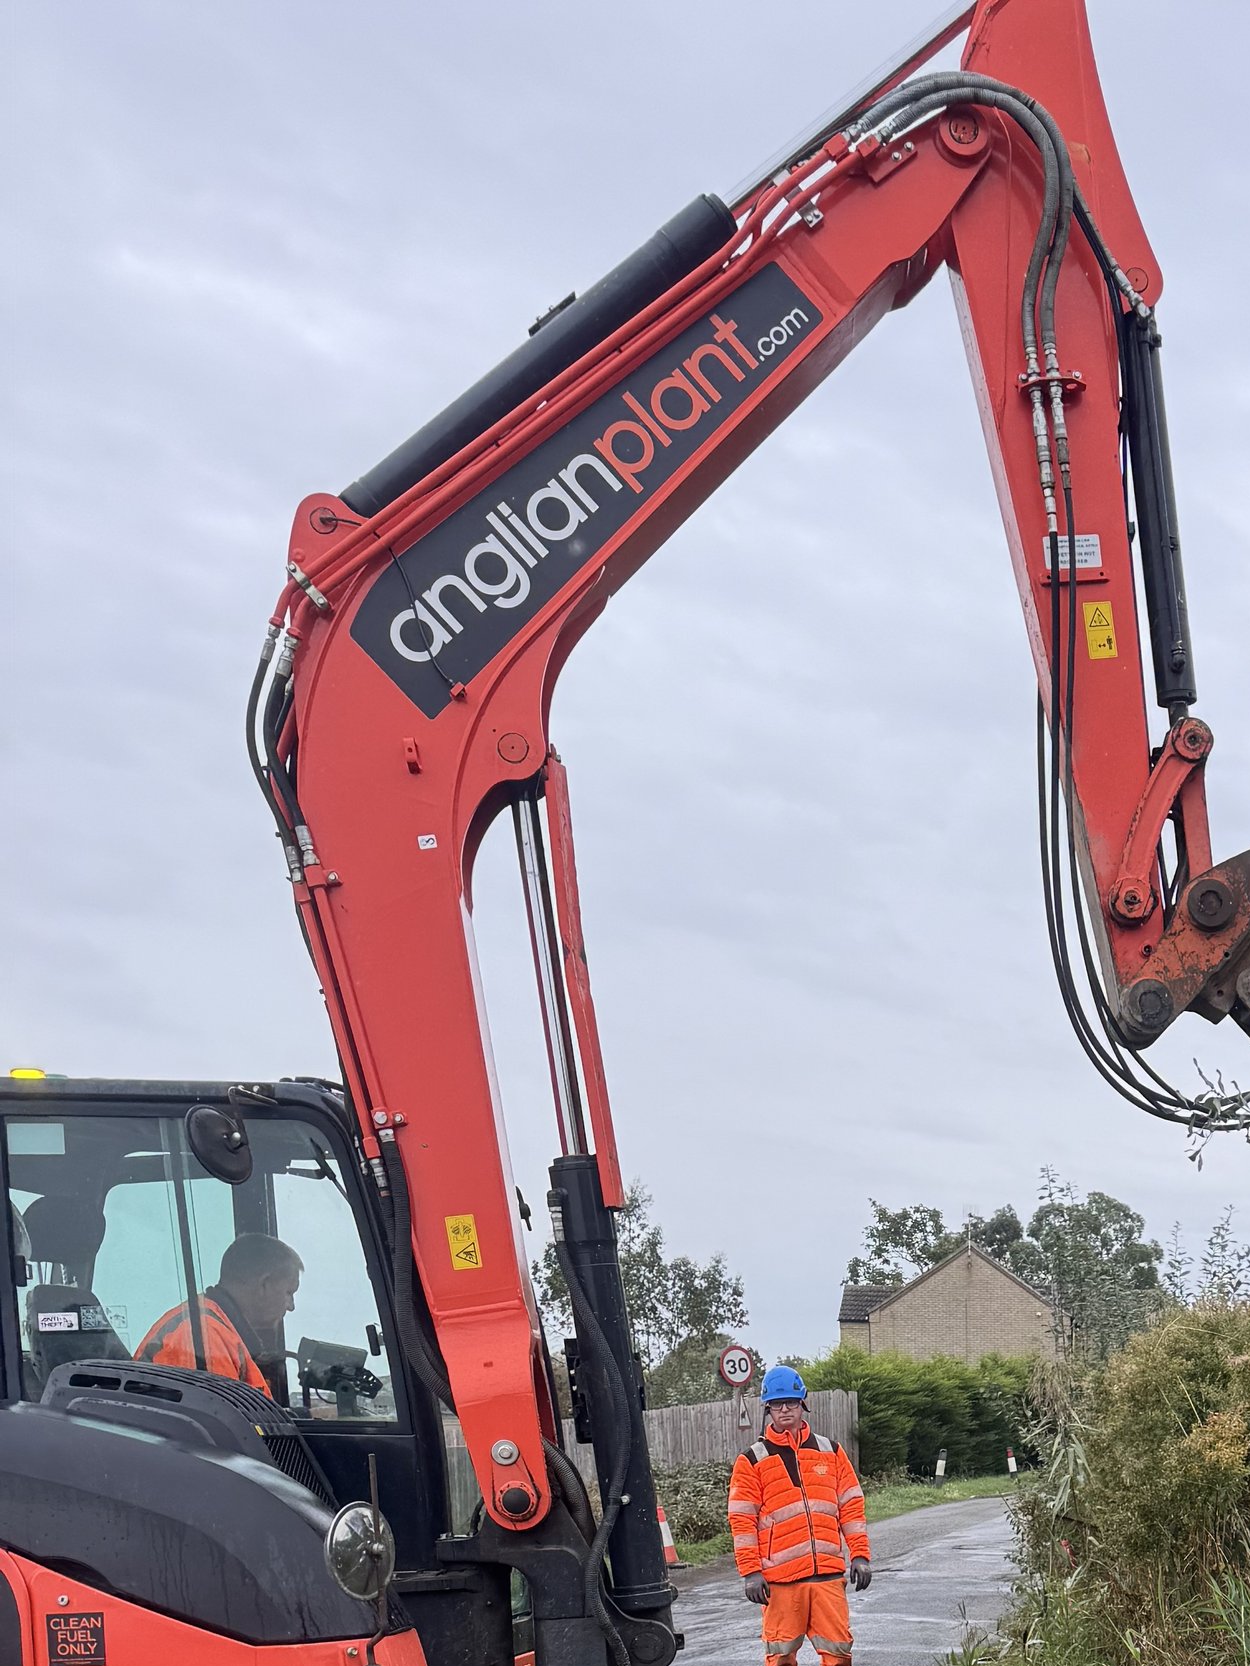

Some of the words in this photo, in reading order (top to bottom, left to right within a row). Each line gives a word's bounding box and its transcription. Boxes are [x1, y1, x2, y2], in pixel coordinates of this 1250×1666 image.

[725, 1357, 749, 1375] 30
[50, 1616, 101, 1630] CLEAN
[57, 1630, 97, 1643] FUEL
[57, 1642, 97, 1656] ONLY
